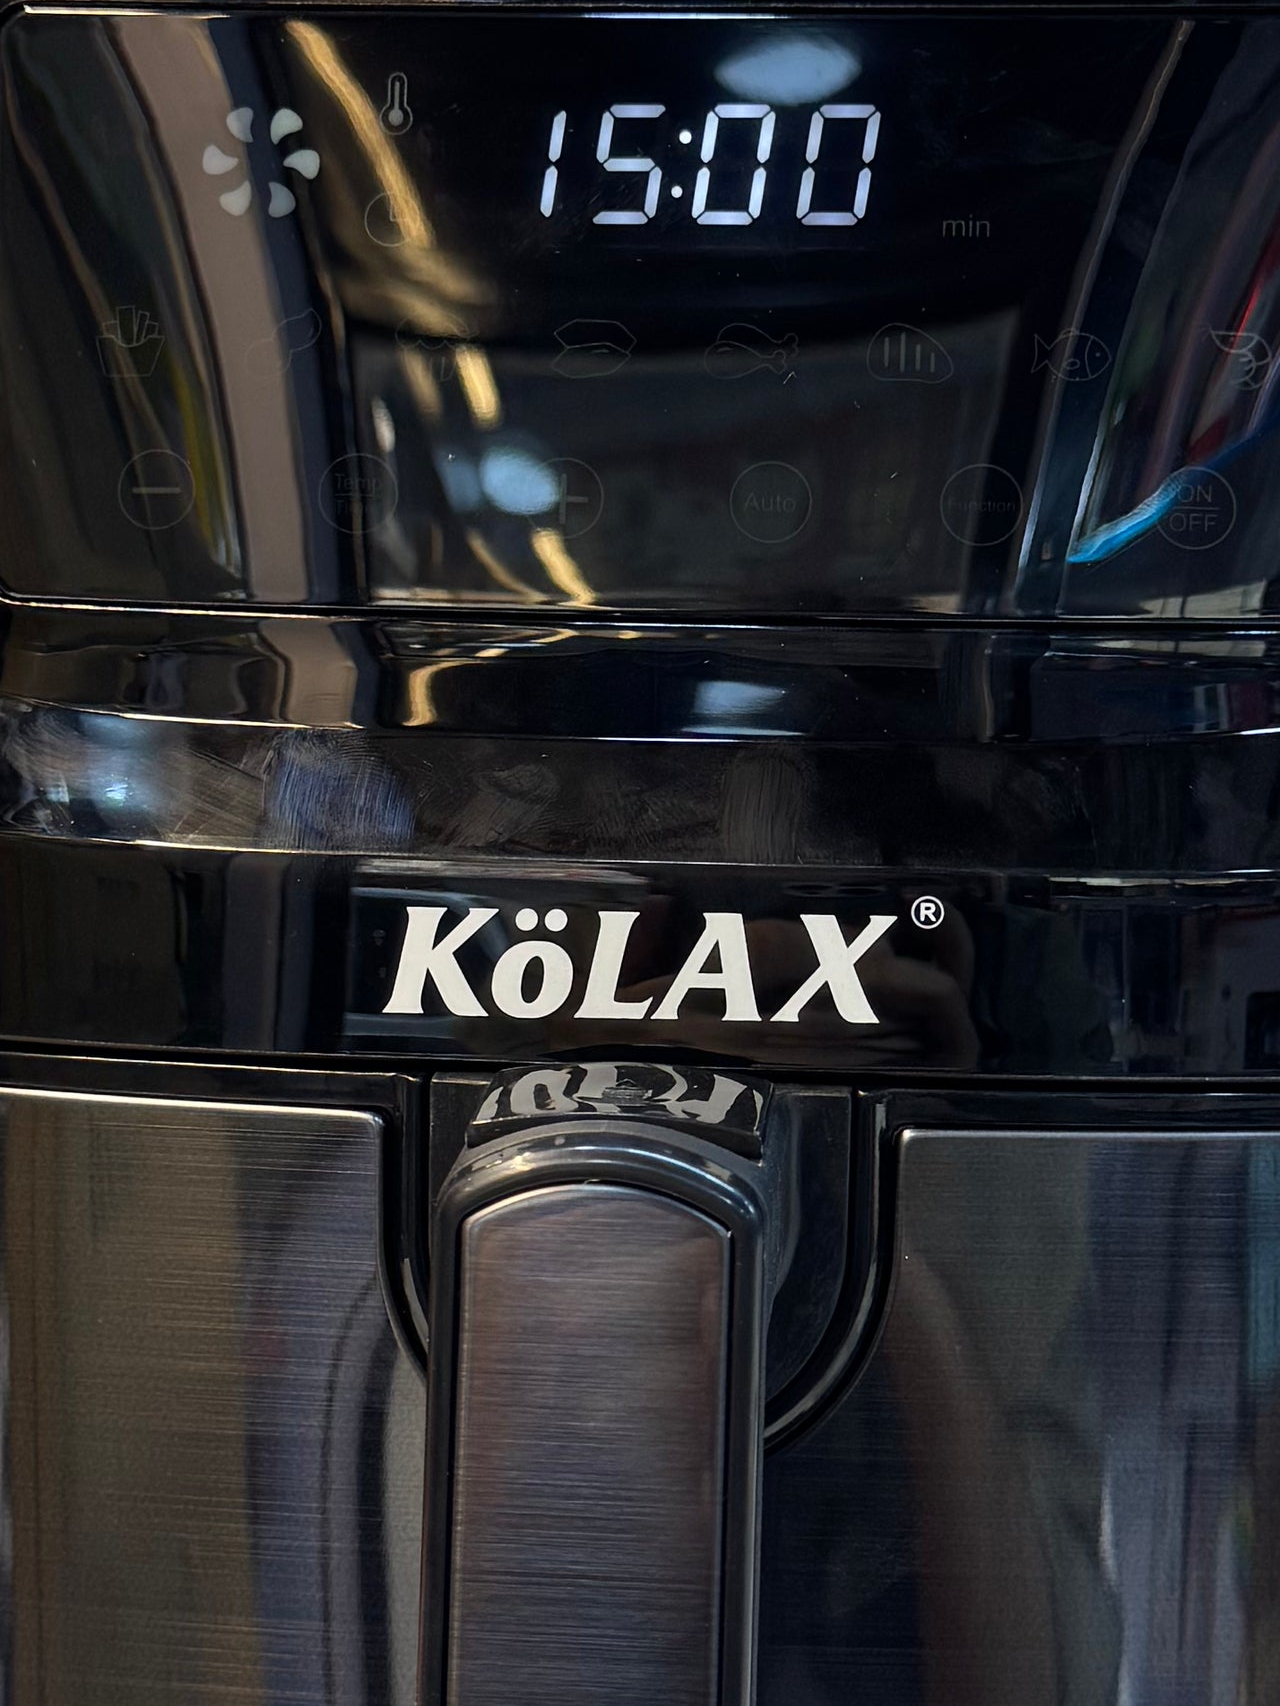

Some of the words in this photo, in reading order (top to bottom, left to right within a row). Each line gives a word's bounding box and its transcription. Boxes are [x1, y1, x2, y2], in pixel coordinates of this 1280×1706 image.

[539, 102, 882, 227] 15:00
[942, 213, 990, 238] min
[743, 492, 797, 513] Auto
[1177, 483, 1213, 503] ON
[1169, 512, 1219, 533] OFF
